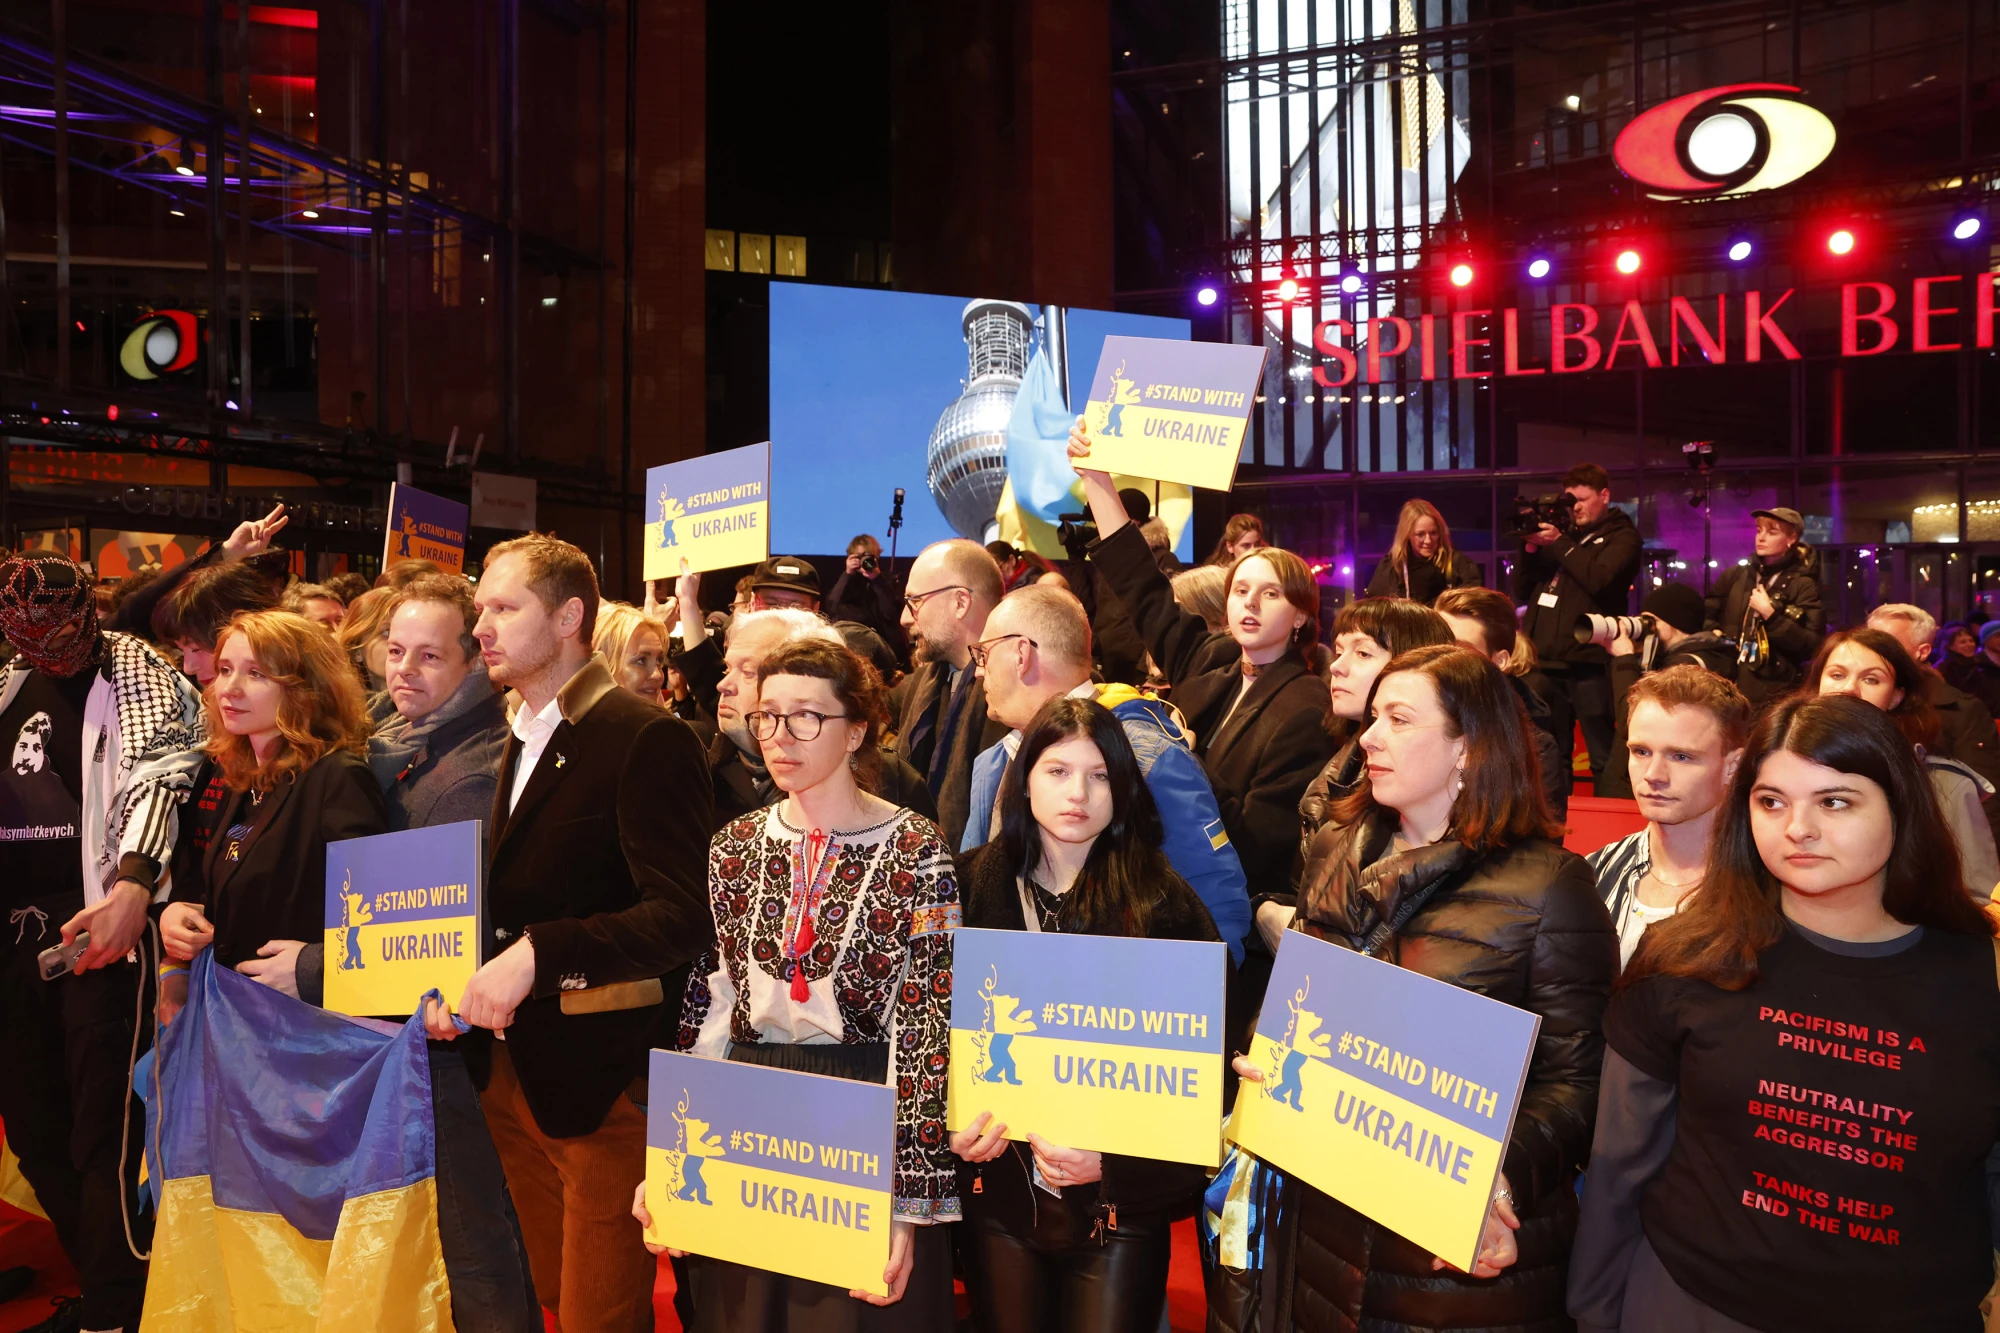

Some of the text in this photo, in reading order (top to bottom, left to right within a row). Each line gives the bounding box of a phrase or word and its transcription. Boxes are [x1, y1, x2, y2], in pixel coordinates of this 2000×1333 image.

[1312, 287, 1802, 387] SPIELBANK
[1145, 384, 1245, 408] #STAND WITH
[1143, 417, 1231, 447] UKRAINE
[687, 481, 762, 509] #STAND WITH
[419, 522, 463, 543] #STAND WITH
[692, 511, 757, 539] UKRAINE
[420, 545, 458, 566] UKRAINE
[375, 883, 468, 913] #STAND WITH
[382, 931, 463, 962] UKRAINE
[1041, 1002, 1208, 1039] #STAND WITH
[1759, 1006, 1927, 1053] PACIFISM IS A
[1777, 1031, 1902, 1071] PRIVILEGE
[1053, 1054, 1198, 1099] UKRAINE
[1337, 1031, 1499, 1119] #STAND WITH
[1747, 1099, 1919, 1152] BENEFITS THE
[1758, 1079, 1914, 1126] NEUTRALITY
[729, 1129, 879, 1177] #STAND WITH
[1333, 1090, 1474, 1186] UKRAINE
[1754, 1123, 1905, 1173] AGGRESSOR
[740, 1179, 870, 1232] UKRAINE
[1741, 1189, 1900, 1246] END THE WAR
[1752, 1171, 1895, 1221] TANKS HELP
